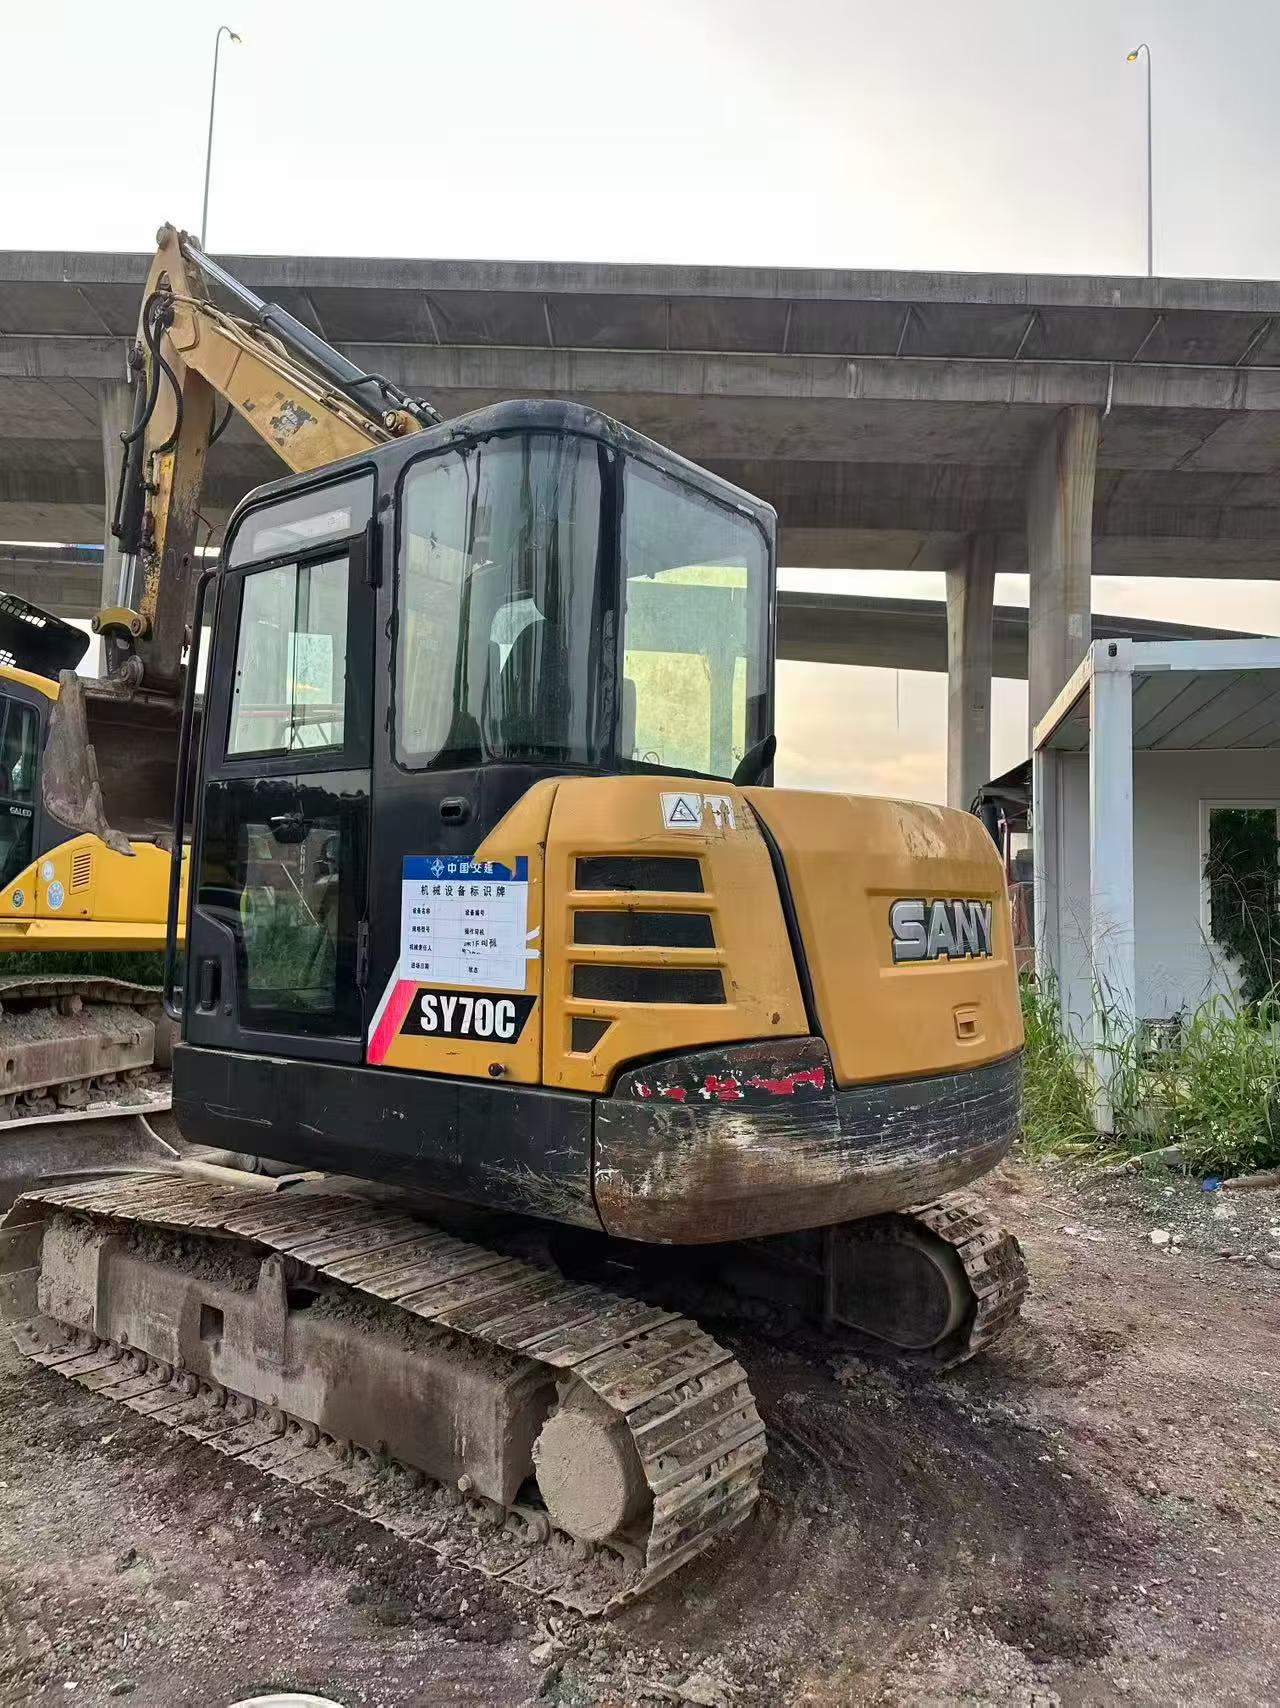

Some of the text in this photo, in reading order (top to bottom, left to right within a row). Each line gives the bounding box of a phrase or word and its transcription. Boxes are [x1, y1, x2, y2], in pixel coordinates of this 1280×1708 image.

[420, 885, 506, 897] 机械设备标识牌
[888, 898, 993, 964] SANY
[420, 994, 516, 1039] SY70C
